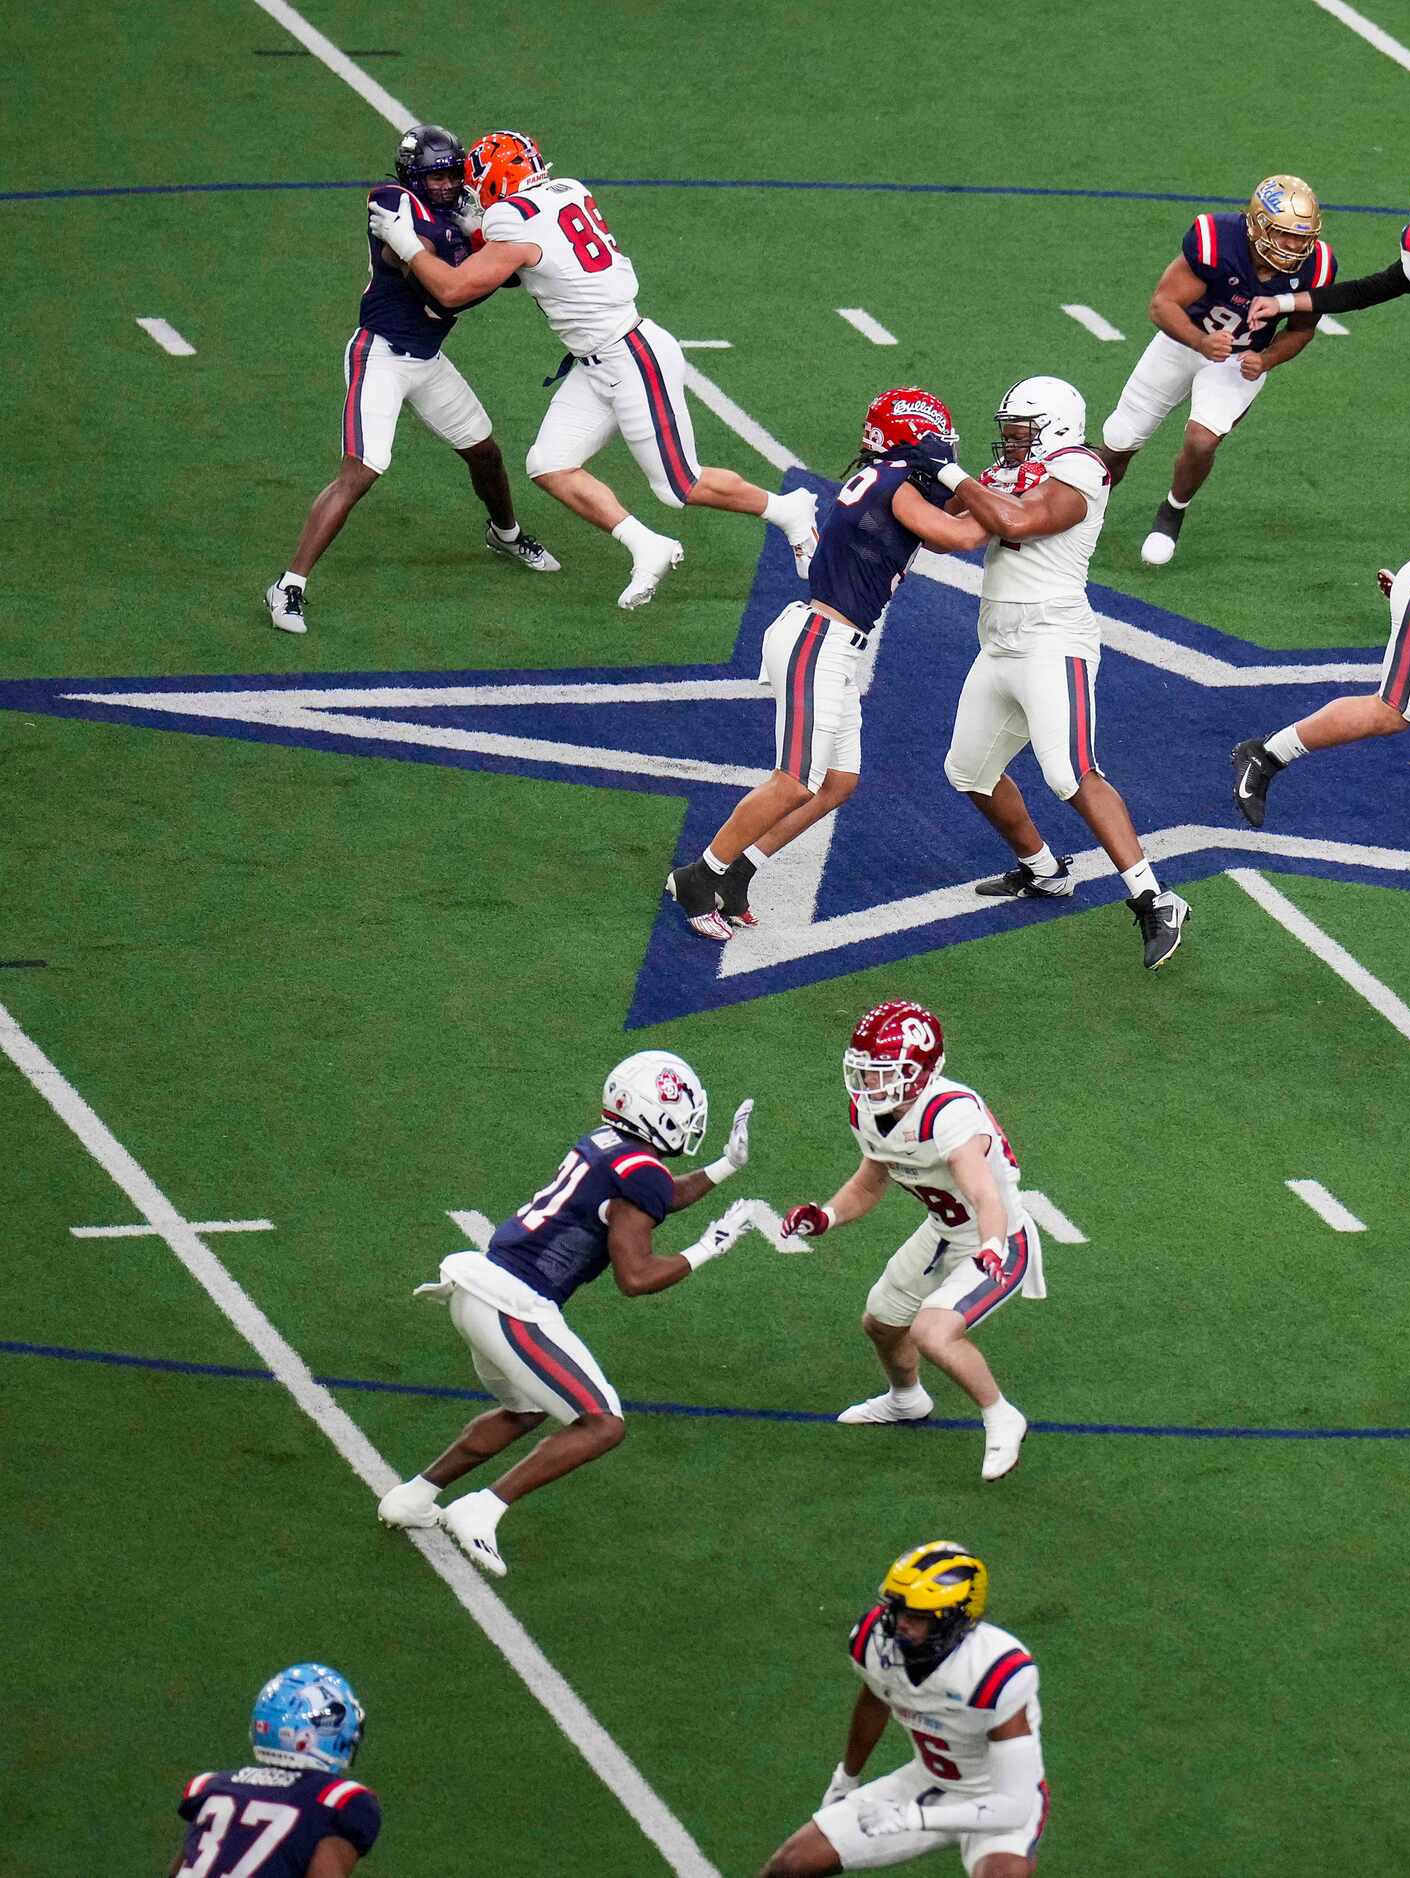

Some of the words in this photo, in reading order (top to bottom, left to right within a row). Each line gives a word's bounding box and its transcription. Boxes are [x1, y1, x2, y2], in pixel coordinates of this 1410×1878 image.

[892, 399, 950, 434] Bulldogs
[911, 1729, 963, 1781] 6
[176, 1796, 300, 1878] 37
